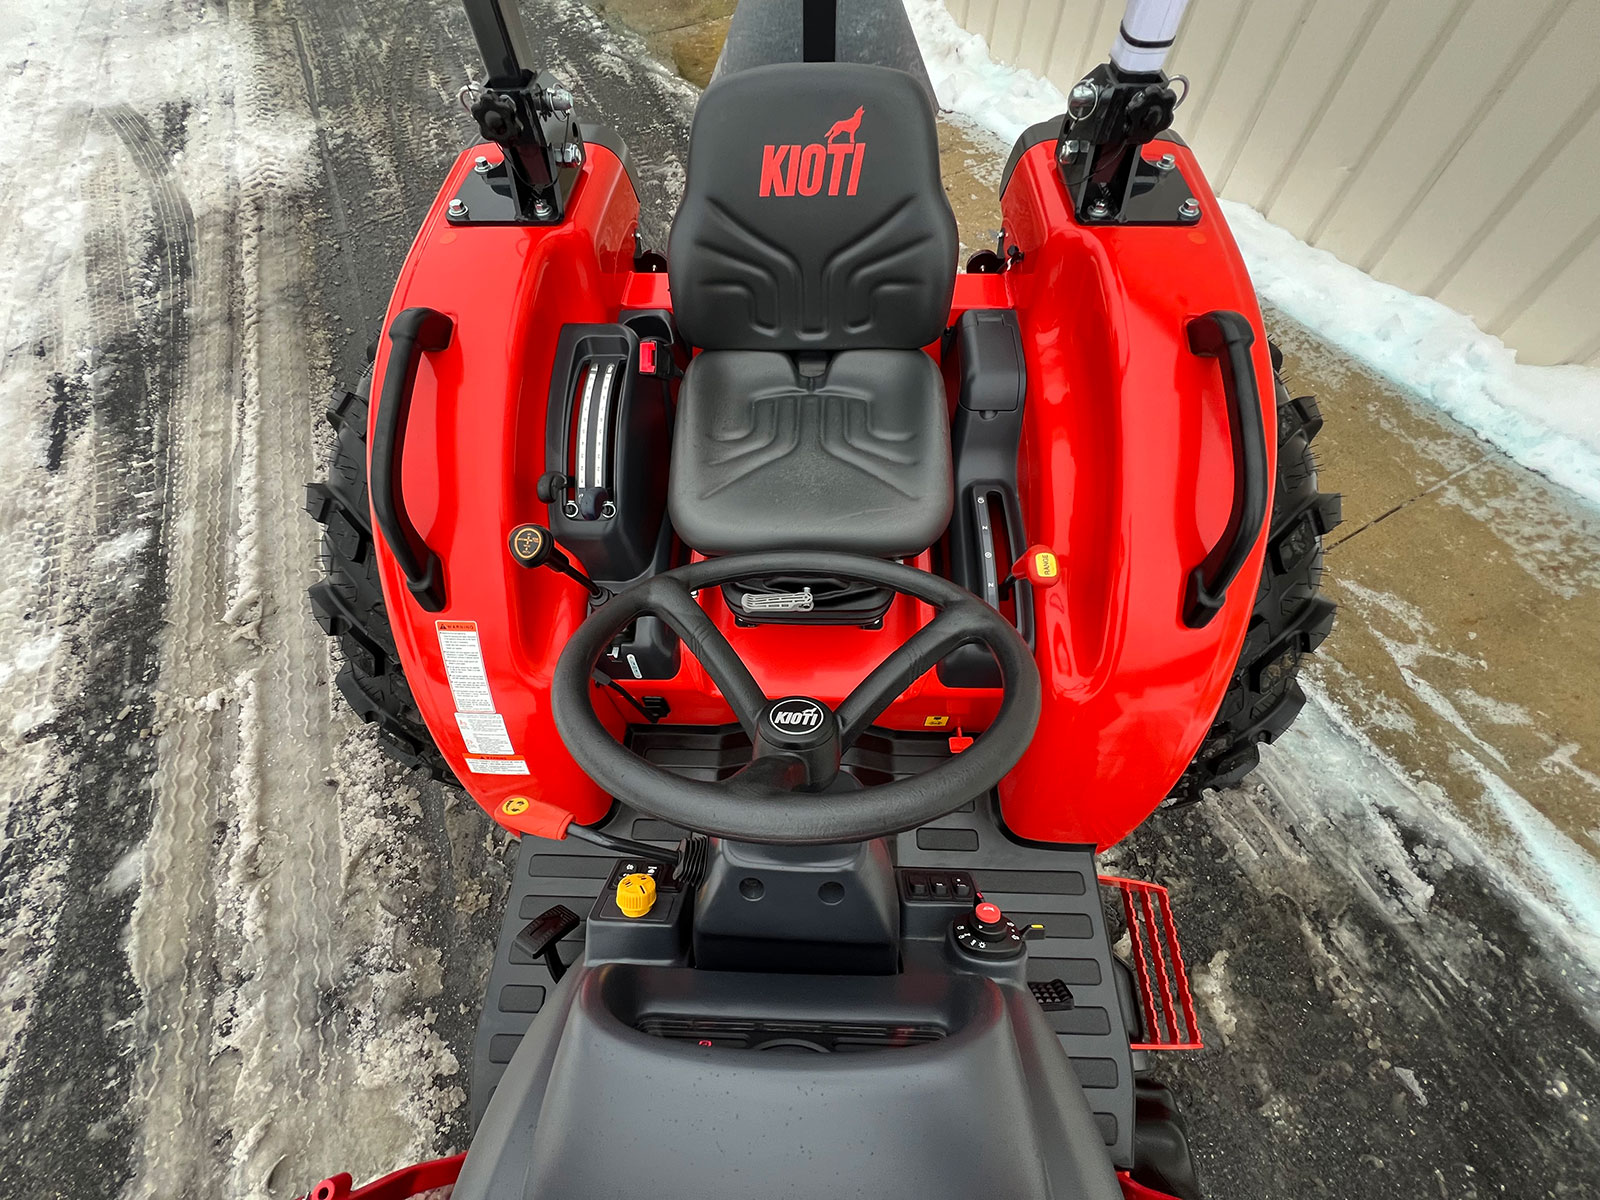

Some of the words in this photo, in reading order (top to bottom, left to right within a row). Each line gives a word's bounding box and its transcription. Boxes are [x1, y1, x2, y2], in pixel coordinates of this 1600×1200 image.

[759, 143, 866, 197] KIOTI
[1042, 555, 1050, 575] RANGE
[774, 711, 818, 725] KIOTI
